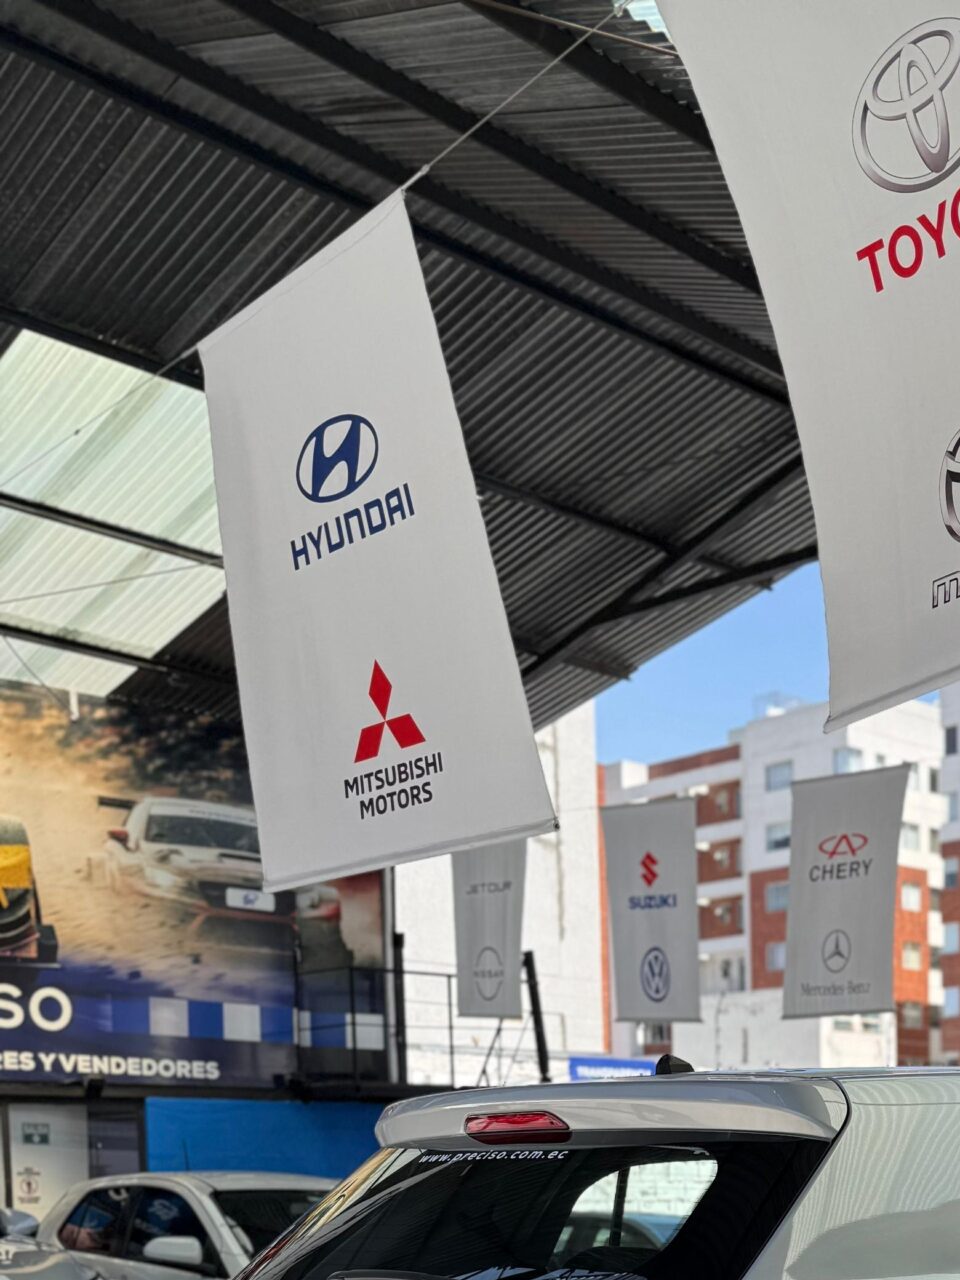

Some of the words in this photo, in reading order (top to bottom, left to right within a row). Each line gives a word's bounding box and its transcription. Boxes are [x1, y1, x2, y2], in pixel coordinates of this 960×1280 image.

[291, 482, 415, 570] HYUNDAI
[344, 752, 443, 799] MITSUBISHI
[360, 781, 433, 819] MOTORS
[809, 859, 872, 882] CHERY
[465, 881, 512, 895] JETOUR
[628, 893, 677, 910] SUZUKI
[801, 980, 871, 997] Mercedes-Benz
[38, 1052, 57, 1071] Y
[58, 1054, 220, 1080] VENDEDORES
[418, 1150, 569, 1164] www.preciso.com.ec
